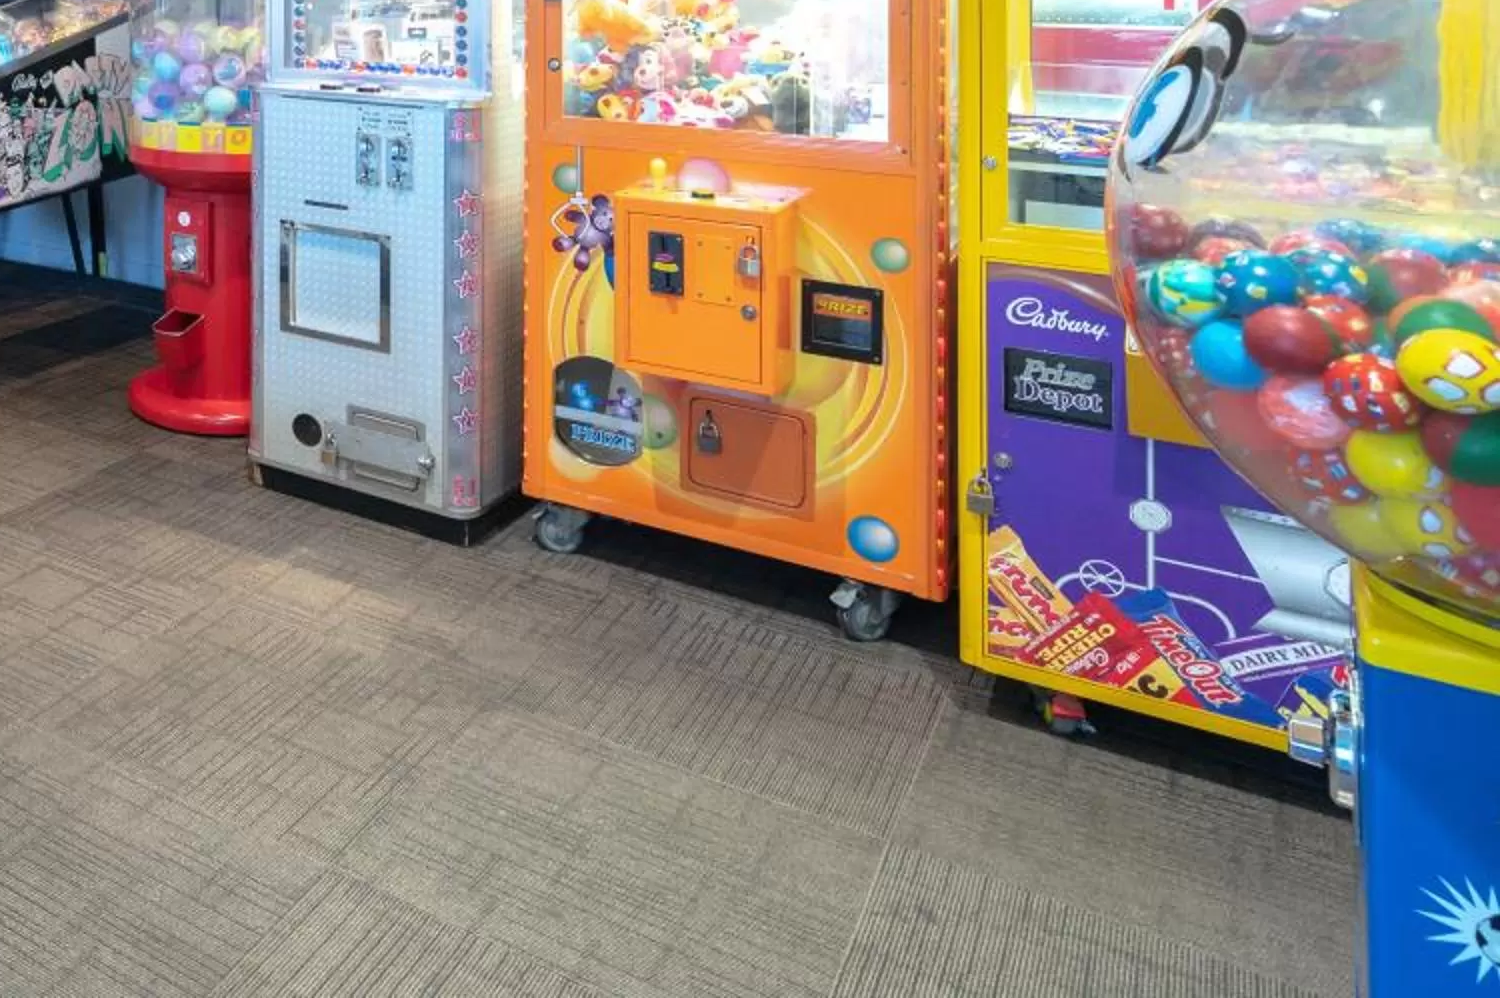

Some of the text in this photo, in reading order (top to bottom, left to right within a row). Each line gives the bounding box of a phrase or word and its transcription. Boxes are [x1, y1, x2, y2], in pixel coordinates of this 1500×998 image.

[1005, 296, 1109, 342] Cadbury
[1019, 357, 1097, 391] Prize
[1012, 375, 1104, 414] Depot
[1229, 647, 1291, 672] DAIRY
